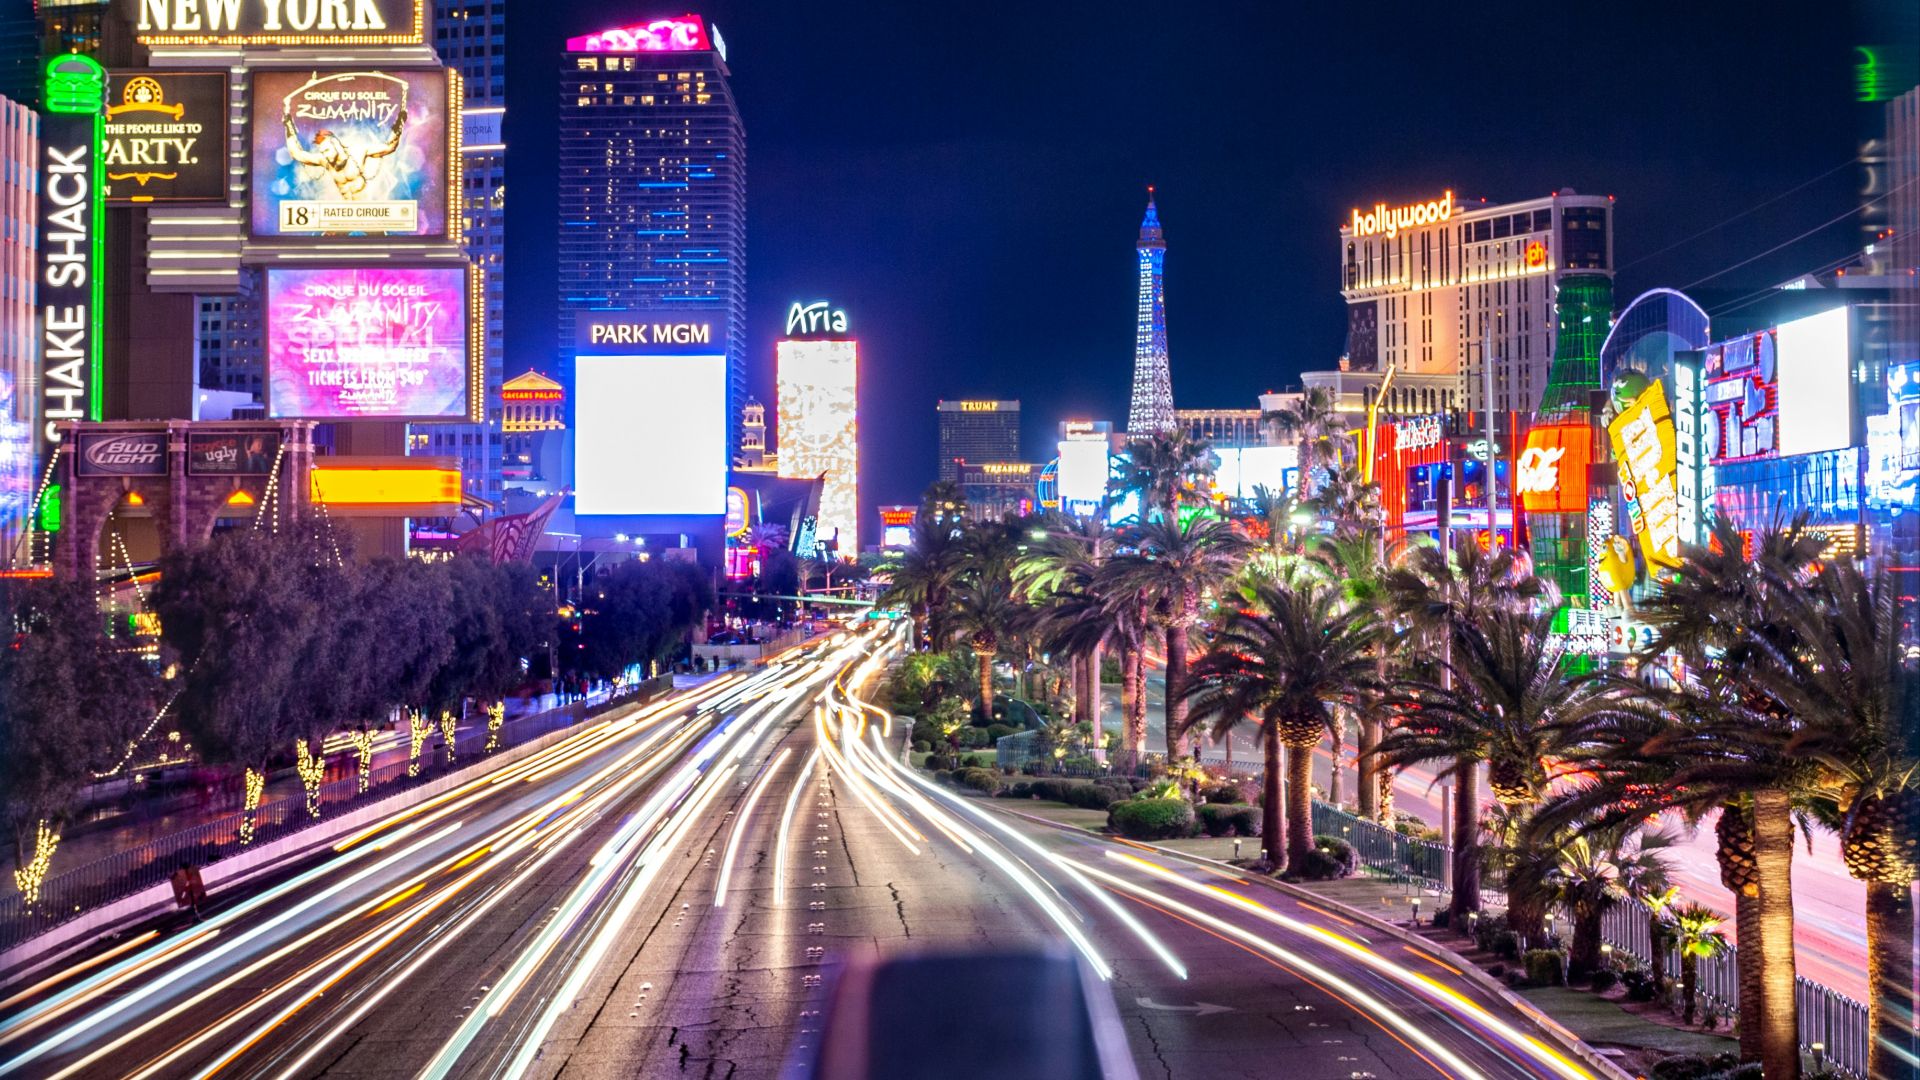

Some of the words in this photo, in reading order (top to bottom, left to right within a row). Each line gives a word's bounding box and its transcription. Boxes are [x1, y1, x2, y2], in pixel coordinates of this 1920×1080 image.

[137, 0, 242, 31] NEW
[263, 0, 387, 31] YORK
[304, 91, 340, 102] CIRQUE
[341, 91, 355, 100] DU
[357, 91, 390, 100] SOLEIL
[104, 123, 125, 134] THE
[126, 123, 162, 134] PEOPLE
[163, 123, 186, 134] LIKE
[186, 123, 202, 134] TO
[47, 144, 88, 288] SHACK
[323, 207, 354, 217] RATED
[356, 207, 390, 218] CIRQUE
[1353, 190, 1451, 239] hollywood
[304, 285, 355, 299] CIRQUE
[358, 285, 379, 296] DU
[382, 285, 428, 297] SOLEIL
[786, 301, 847, 336] Aria
[592, 324, 648, 344] PARK
[653, 324, 709, 344] MGM
[303, 348, 334, 363] SEXY
[308, 370, 357, 386] TICKETS
[360, 368, 396, 385] FROM
[961, 401, 998, 412] TRUMP
[106, 442, 159, 454] BUD
[205, 446, 238, 462] ugly
[95, 453, 161, 464] LIGHT
